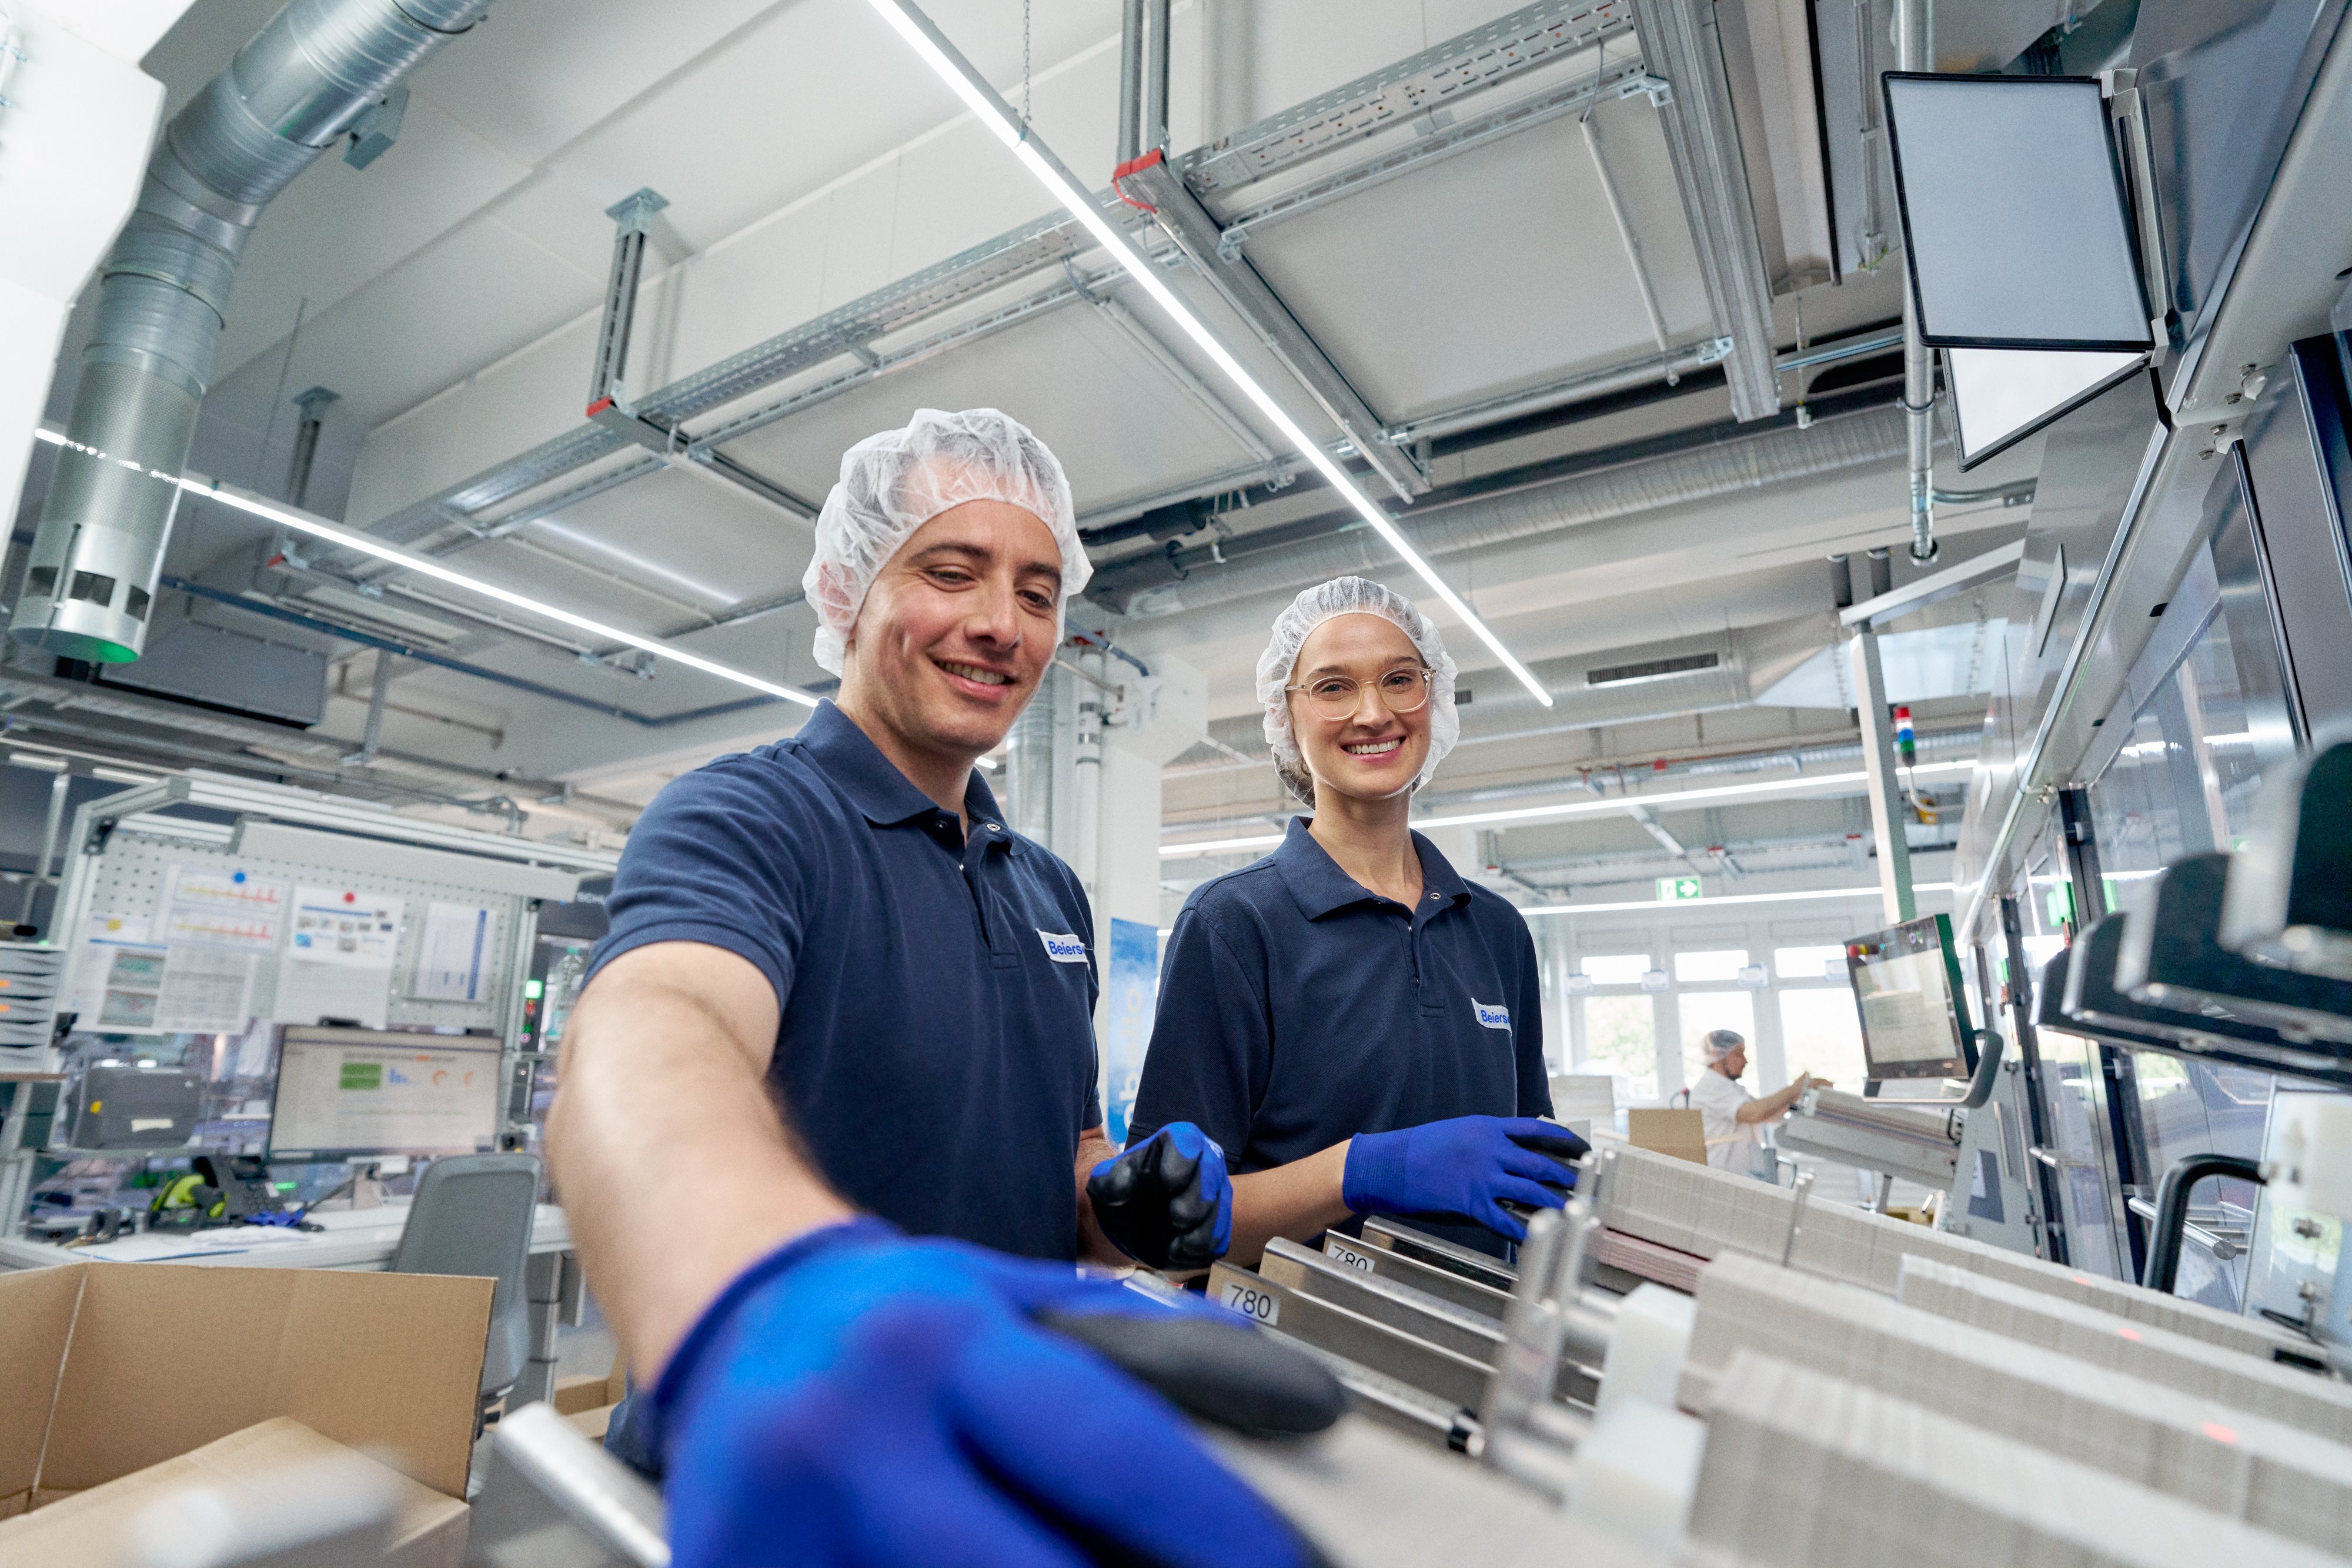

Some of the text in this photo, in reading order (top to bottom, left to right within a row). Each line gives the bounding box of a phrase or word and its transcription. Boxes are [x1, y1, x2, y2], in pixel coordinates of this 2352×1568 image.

[1048, 941, 1085, 955] Beiers
[1119, 987, 1142, 1154] bello
[1231, 1285, 1271, 1318] 780
